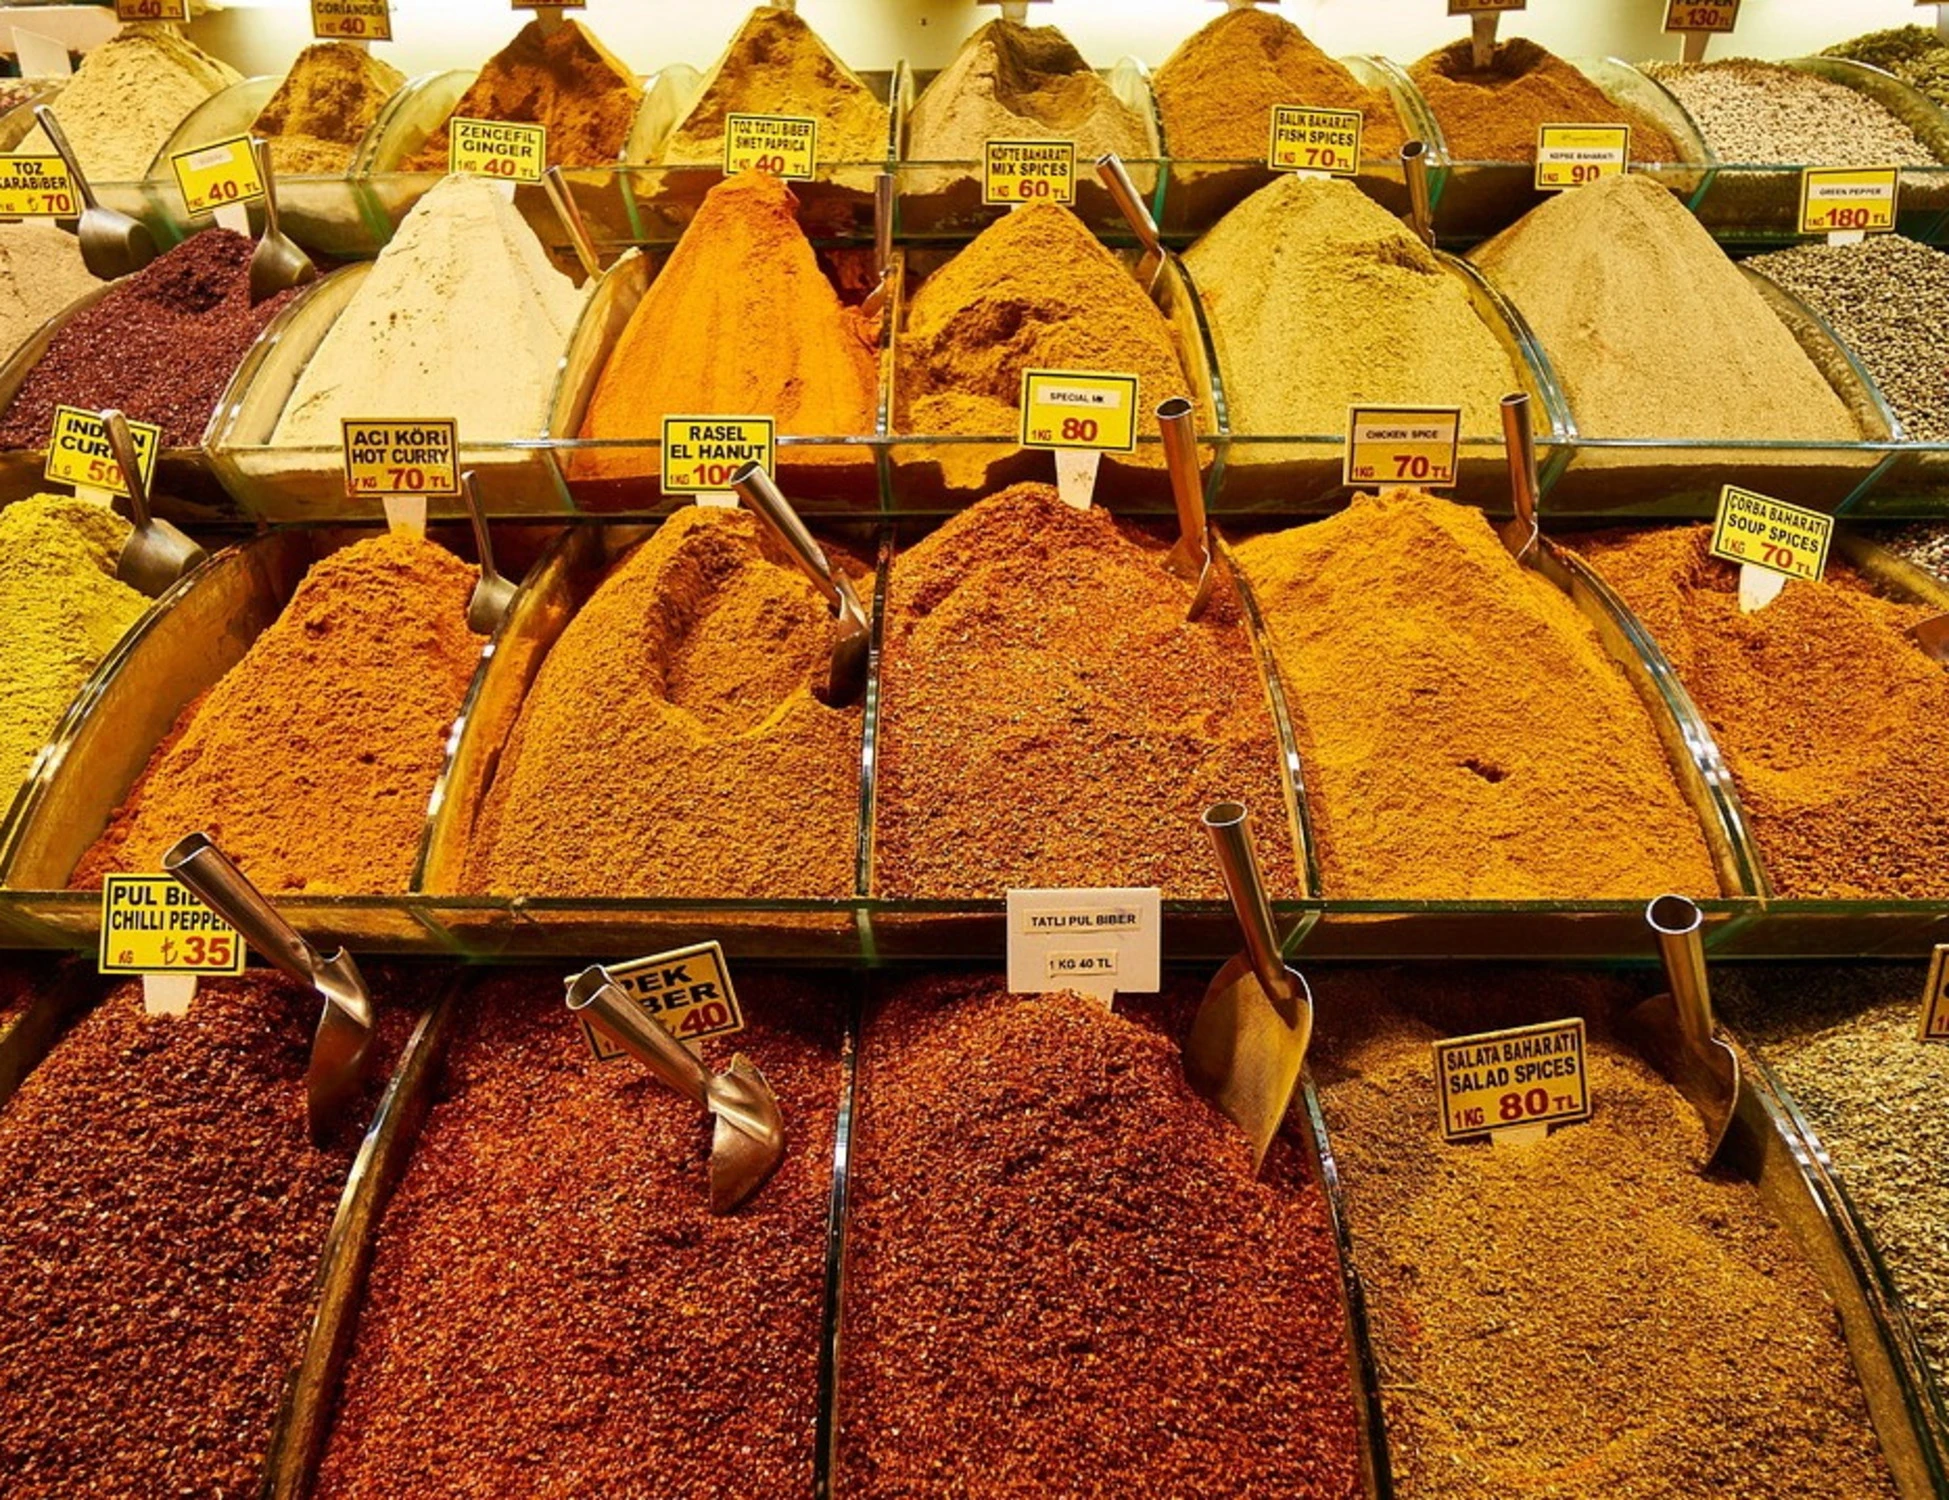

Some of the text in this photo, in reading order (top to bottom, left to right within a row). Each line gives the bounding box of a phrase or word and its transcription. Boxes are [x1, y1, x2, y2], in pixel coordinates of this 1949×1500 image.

[139, 0, 161, 18] 40
[316, 2, 385, 16] CORIANDER
[1687, 8, 1718, 26] 130
[340, 17, 366, 33] 40
[1278, 129, 1355, 147] FISH SPICES
[462, 139, 532, 158] GINGER
[1305, 148, 1336, 167] 70
[12, 161, 44, 175] TOZ
[483, 158, 516, 176] 40
[520, 166, 537, 178] TL
[755, 154, 785, 174] 40
[991, 162, 1068, 177] MIX SPICES
[1571, 164, 1601, 184] 90
[208, 180, 238, 201] 40
[244, 181, 259, 193] TL
[1018, 178, 1050, 199] 60
[1052, 188, 1068, 199] TL
[1819, 187, 1882, 196] GREEN PEPPER
[1825, 206, 1870, 230] 180
[1873, 213, 1889, 225] TL
[1050, 391, 1088, 402] SPECIAL
[354, 430, 389, 446] ACI
[689, 425, 747, 441] RASEL
[1061, 417, 1098, 442] 80
[1365, 429, 1439, 440] CHICKEN SPICE
[352, 447, 450, 464] HOT CURRY
[670, 444, 766, 460] EL HANUT
[87, 458, 121, 486] 50
[1392, 455, 1430, 479] 70
[1431, 464, 1450, 479] TL
[387, 467, 425, 490] 70
[430, 476, 451, 488] TL
[1727, 513, 1819, 554] SOUP SPICES
[1760, 542, 1794, 569] 70
[1796, 561, 1814, 578] TL
[113, 886, 157, 906] PUL
[112, 910, 164, 931] CHILLI
[1031, 916, 1066, 927] TATLI
[1068, 916, 1093, 926] PUL
[1058, 959, 1076, 969] KG
[1079, 959, 1094, 969] 40
[1096, 958, 1113, 968] TL
[1447, 1033, 1577, 1072] SALATA BAHARATI
[1450, 1056, 1576, 1094] SALAD SPICES
[1499, 1088, 1549, 1121] 80
[1551, 1094, 1580, 1112] TL
